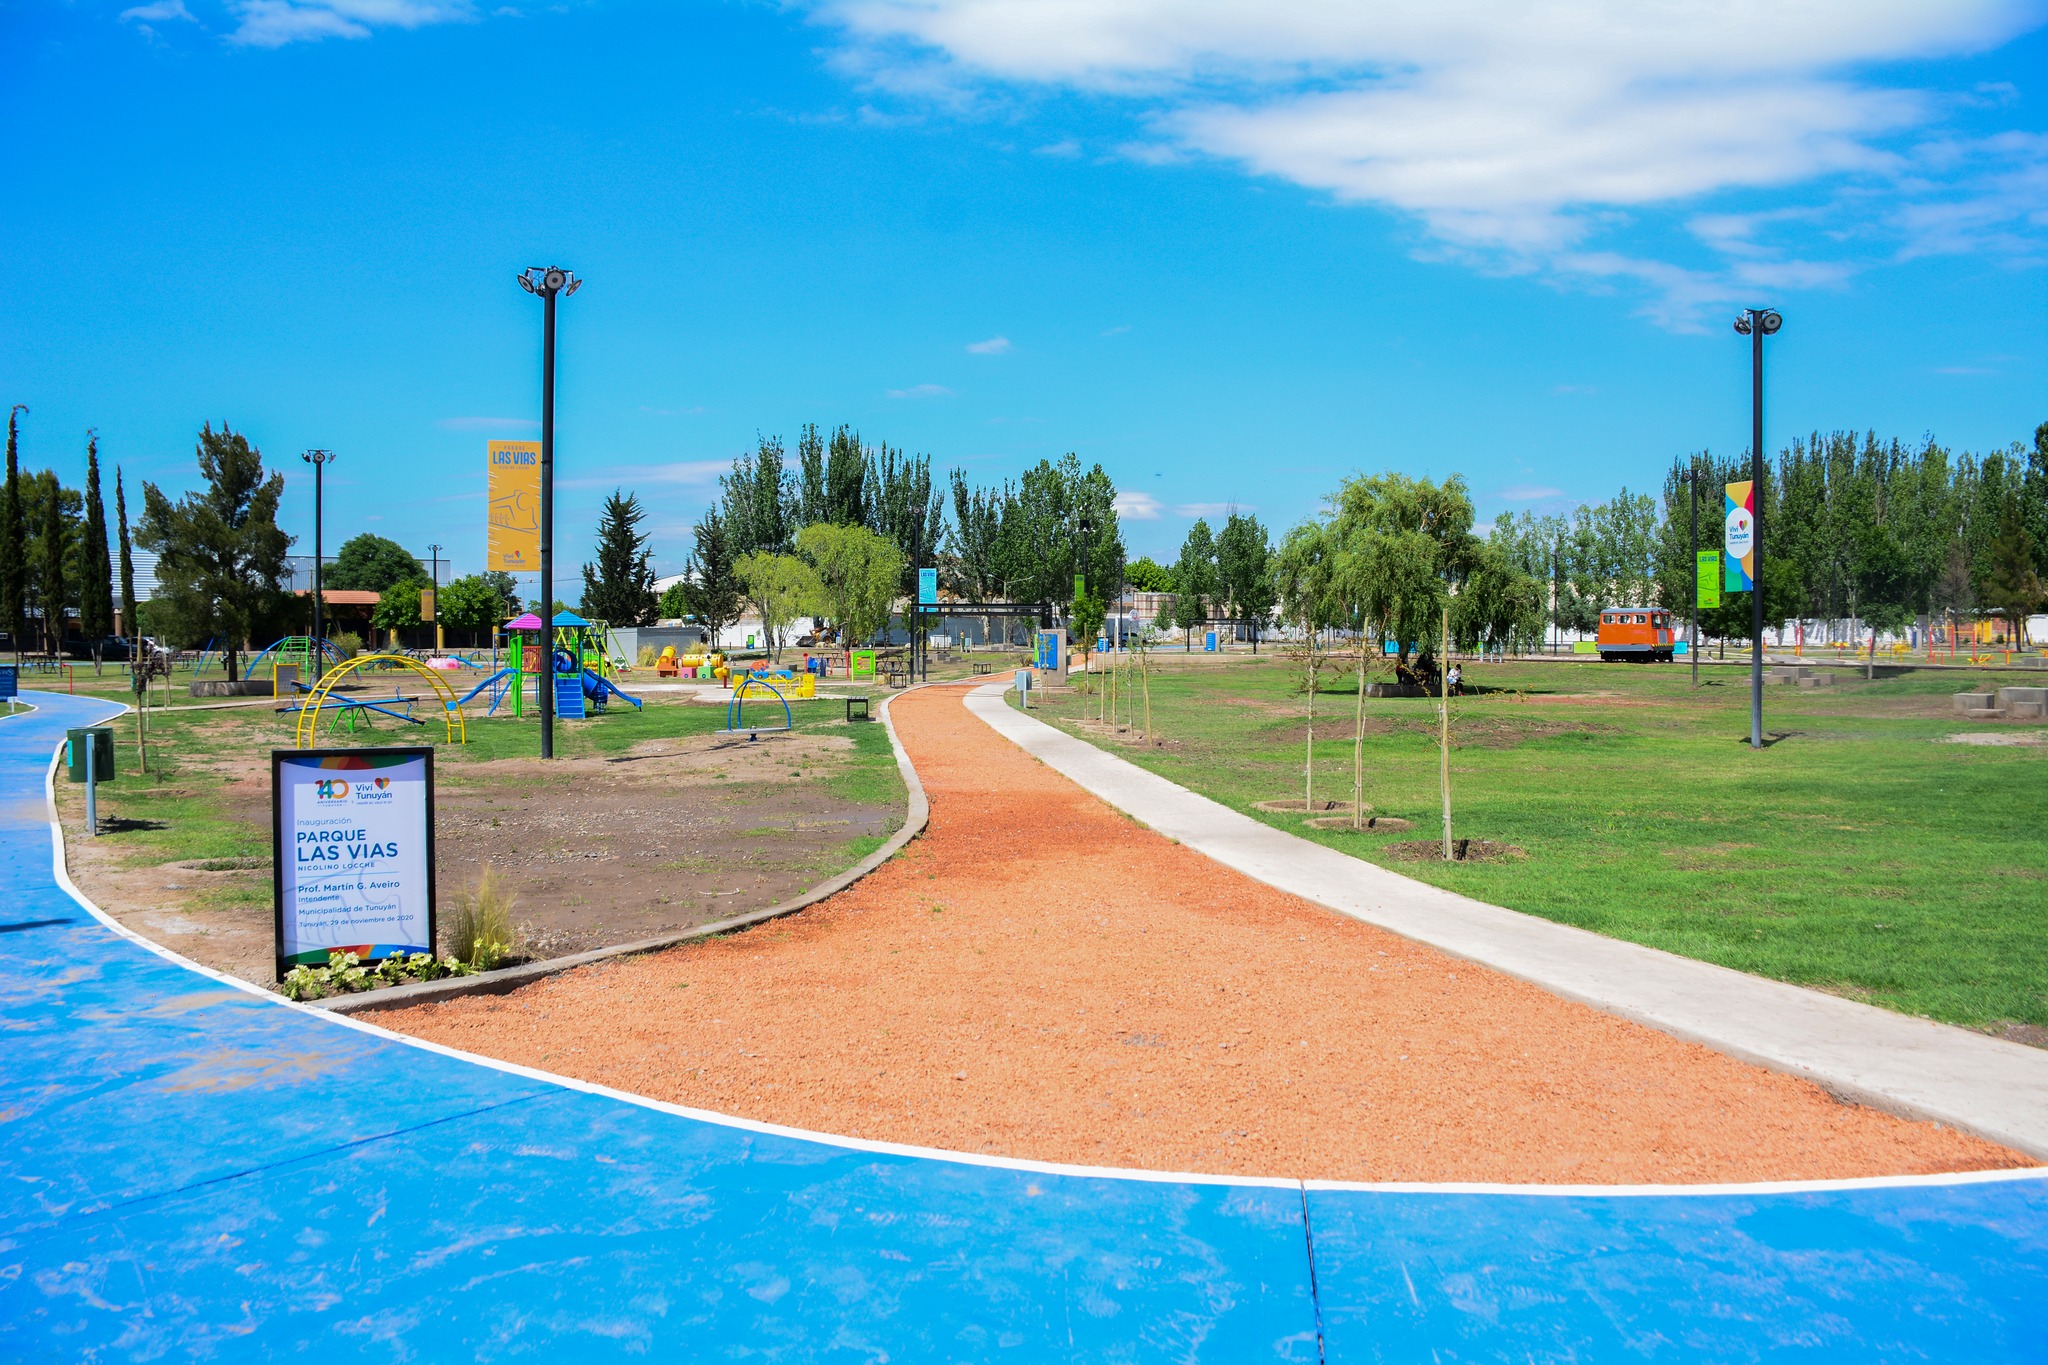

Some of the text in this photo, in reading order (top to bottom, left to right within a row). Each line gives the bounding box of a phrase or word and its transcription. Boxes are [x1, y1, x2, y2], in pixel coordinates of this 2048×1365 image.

[493, 451, 536, 465] LAS VIAS
[1729, 532, 1749, 540] Tunuyán
[315, 779, 349, 799] 140
[355, 783, 373, 791] Viví
[355, 791, 393, 800] Tunuyán
[297, 818, 352, 827] Inauguración
[297, 829, 366, 844] PARQUE
[298, 842, 398, 862] LAS VIAS
[298, 881, 400, 893] Prof. Martín G. Aveiro
[298, 895, 340, 903] Intendente
[299, 907, 351, 915] Municipalidad
[299, 920, 329, 928] Tunuyán,
